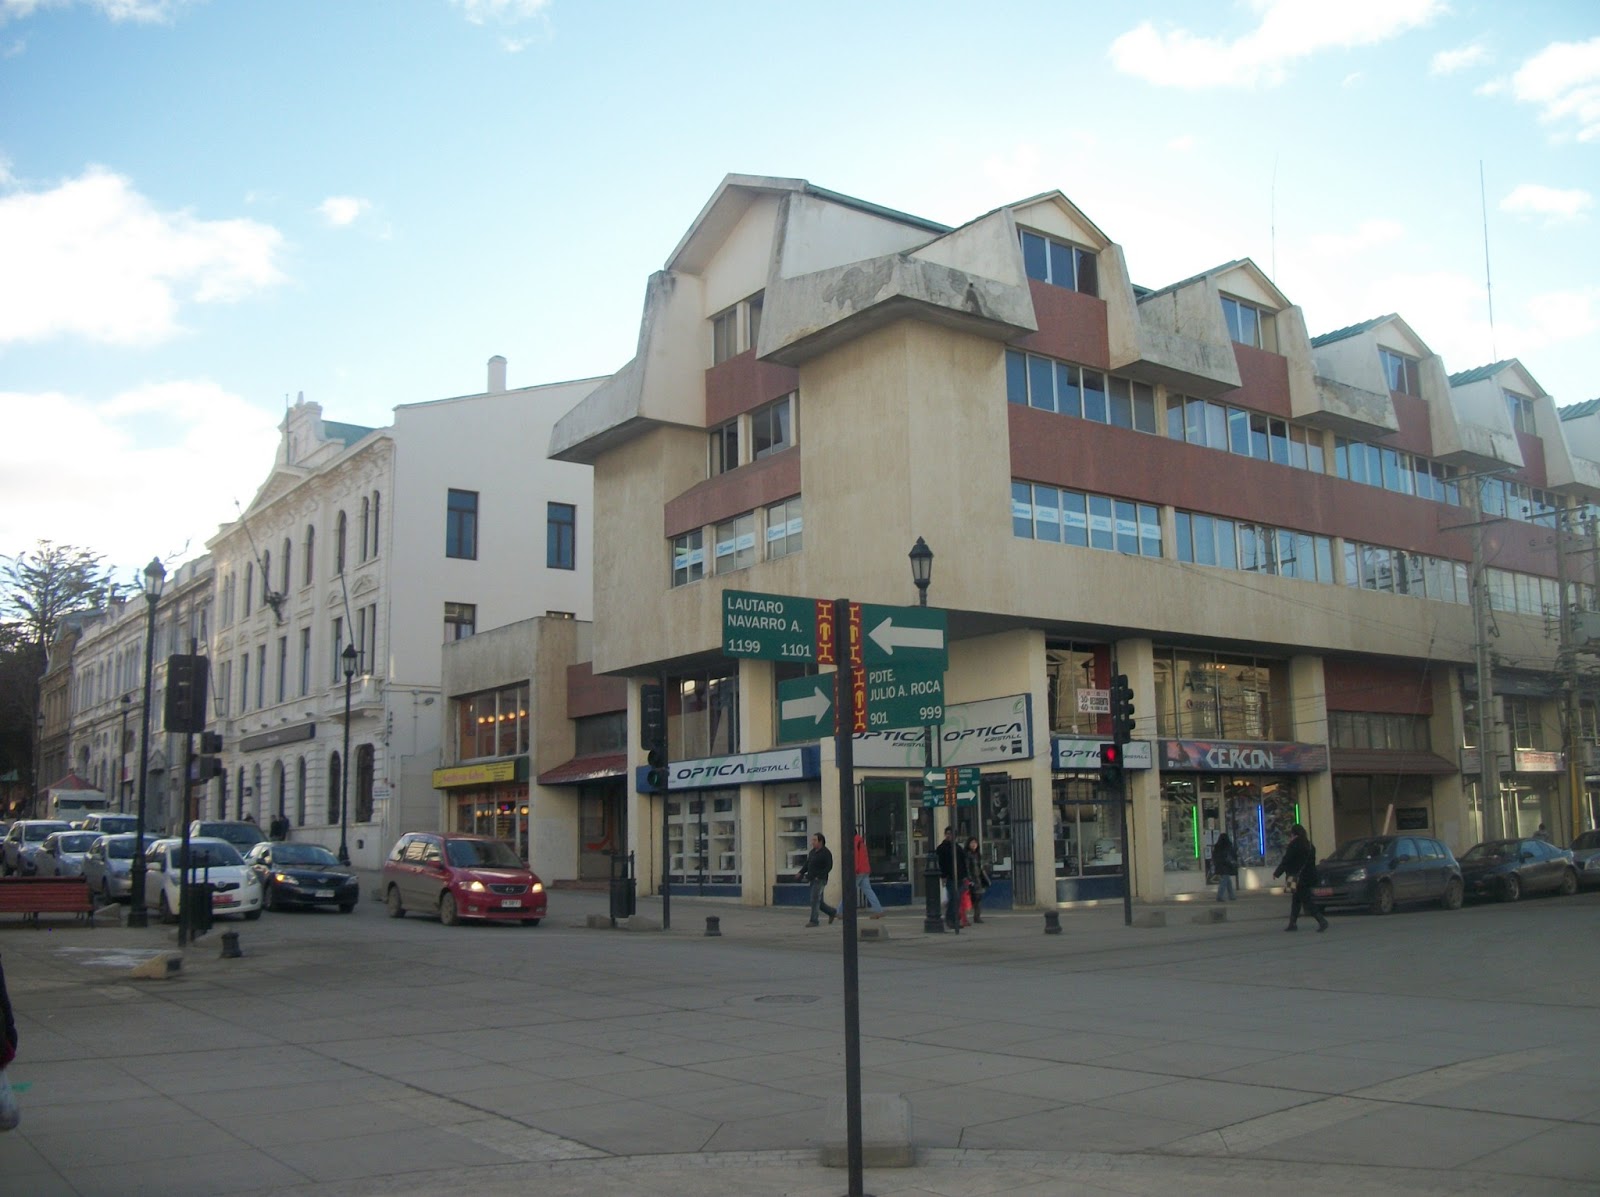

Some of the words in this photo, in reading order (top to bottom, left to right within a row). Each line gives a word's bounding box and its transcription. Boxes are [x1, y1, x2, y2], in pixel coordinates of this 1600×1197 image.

[727, 597, 784, 614] LAUTARO
[727, 614, 786, 631] NAVARRO
[791, 620, 803, 633] A.
[728, 639, 761, 653] 1199
[781, 643, 812, 657] 1101
[869, 669, 896, 684] PDTE.
[870, 686, 896, 701] JULIO
[898, 684, 908, 697] A.
[910, 680, 941, 696] ROCA
[870, 711, 889, 725] 901
[919, 706, 942, 720] 999
[944, 723, 1022, 742] OPTICA
[984, 734, 1022, 743] KRISTALL
[1060, 750, 1102, 758] OPTI
[1205, 749, 1274, 769] CERCON
[677, 764, 745, 780] OPTICA
[746, 765, 790, 774] KRISTALL
